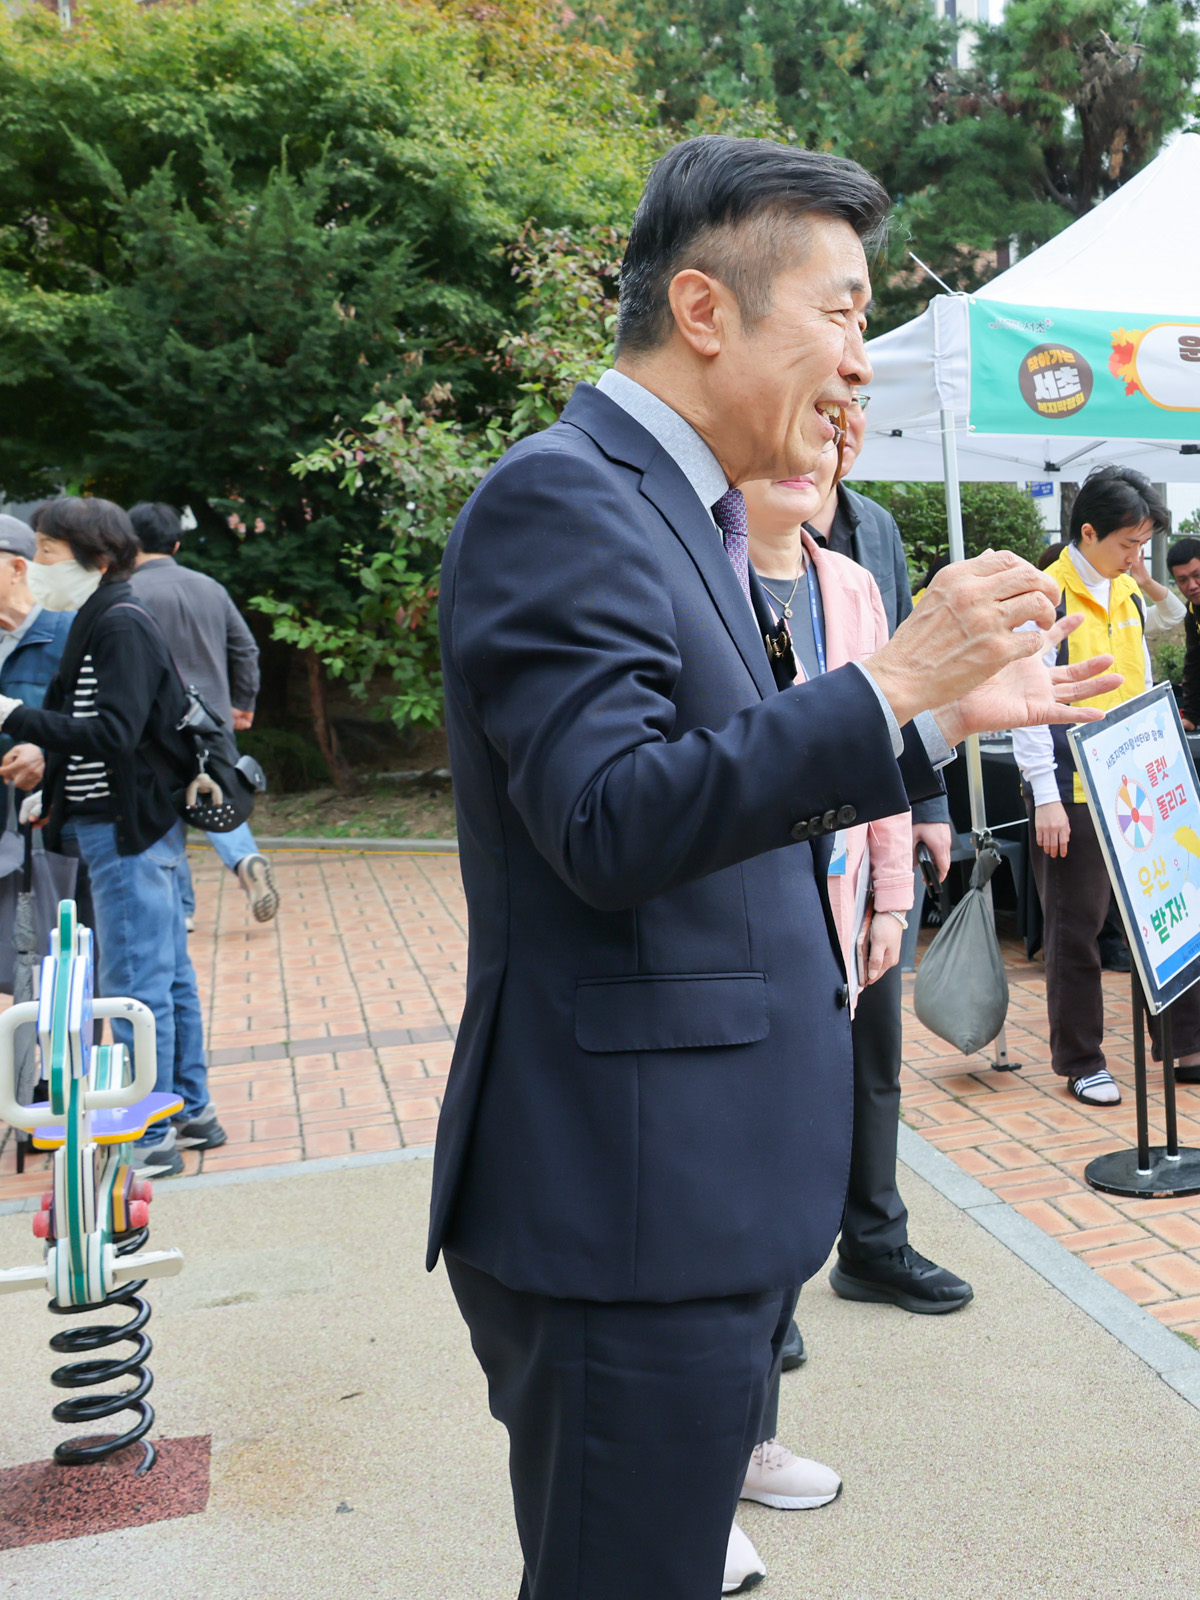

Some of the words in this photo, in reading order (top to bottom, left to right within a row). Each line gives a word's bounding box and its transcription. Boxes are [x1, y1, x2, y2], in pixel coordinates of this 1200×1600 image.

[1024, 321, 1047, 334] 서초
[1026, 349, 1076, 373] 찾아가는
[1033, 366, 1081, 400] 서초
[1036, 391, 1085, 413] 복지박람회
[1106, 731, 1151, 770] 서초지역자활센터와
[1150, 729, 1165, 742] 함께
[1145, 755, 1170, 788] 룰렛
[1156, 783, 1187, 821] 돌리고
[1137, 855, 1170, 898] 우산
[1150, 892, 1189, 945] 받자!
